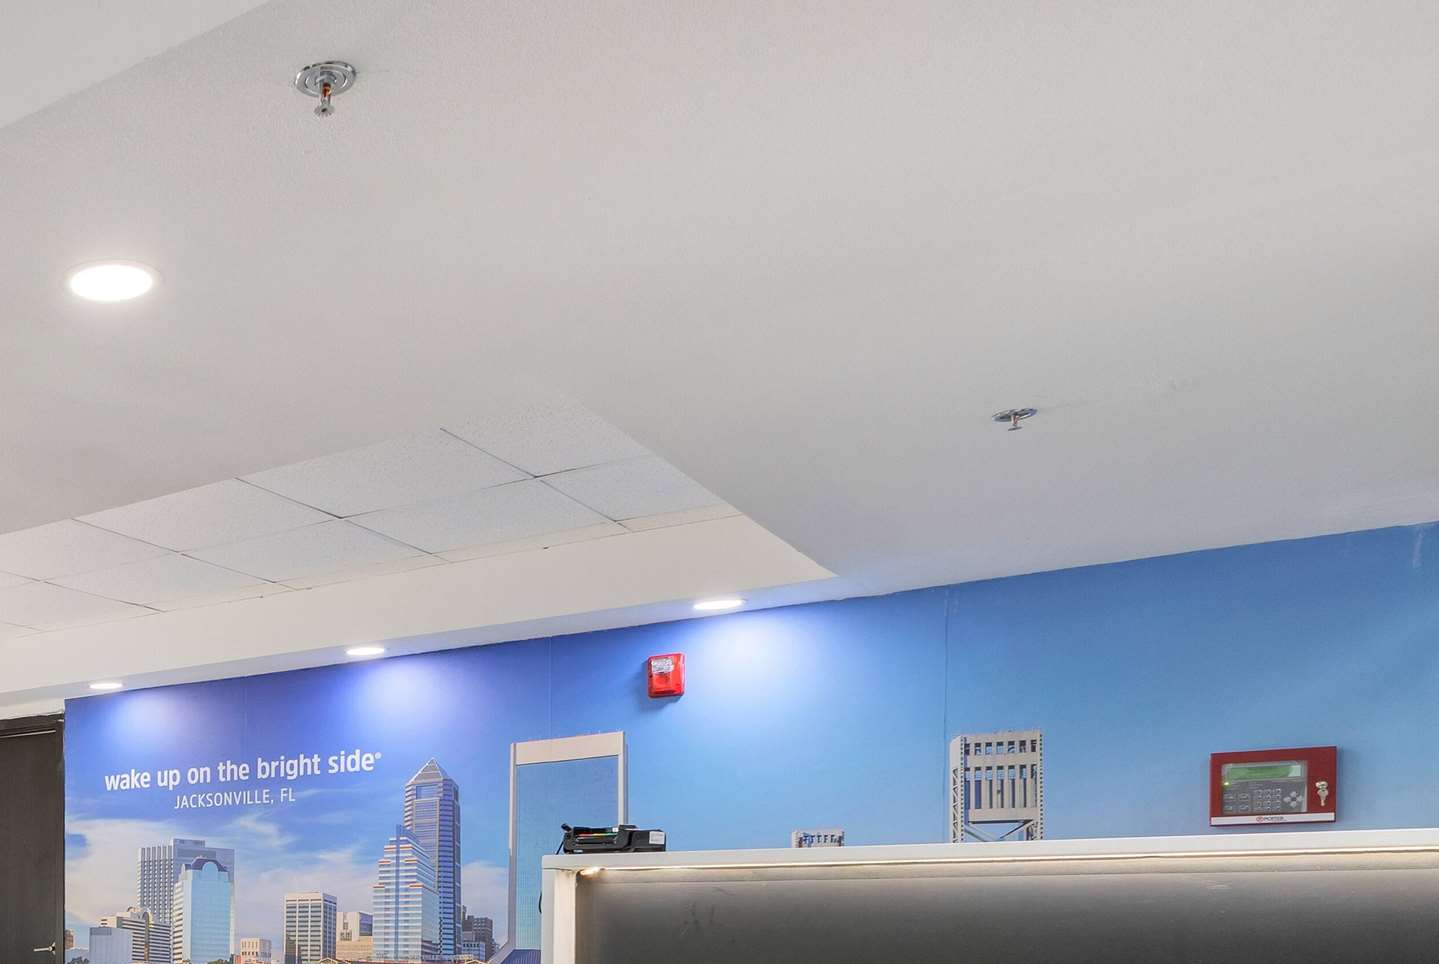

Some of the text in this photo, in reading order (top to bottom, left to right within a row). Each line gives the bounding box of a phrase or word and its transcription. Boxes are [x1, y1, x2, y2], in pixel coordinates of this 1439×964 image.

[104, 768, 151, 792] wake
[157, 768, 181, 791] up
[187, 765, 212, 786] on
[217, 760, 250, 782] the
[257, 753, 321, 781] bright
[174, 787, 297, 809] JACKSONVILLE, FL
